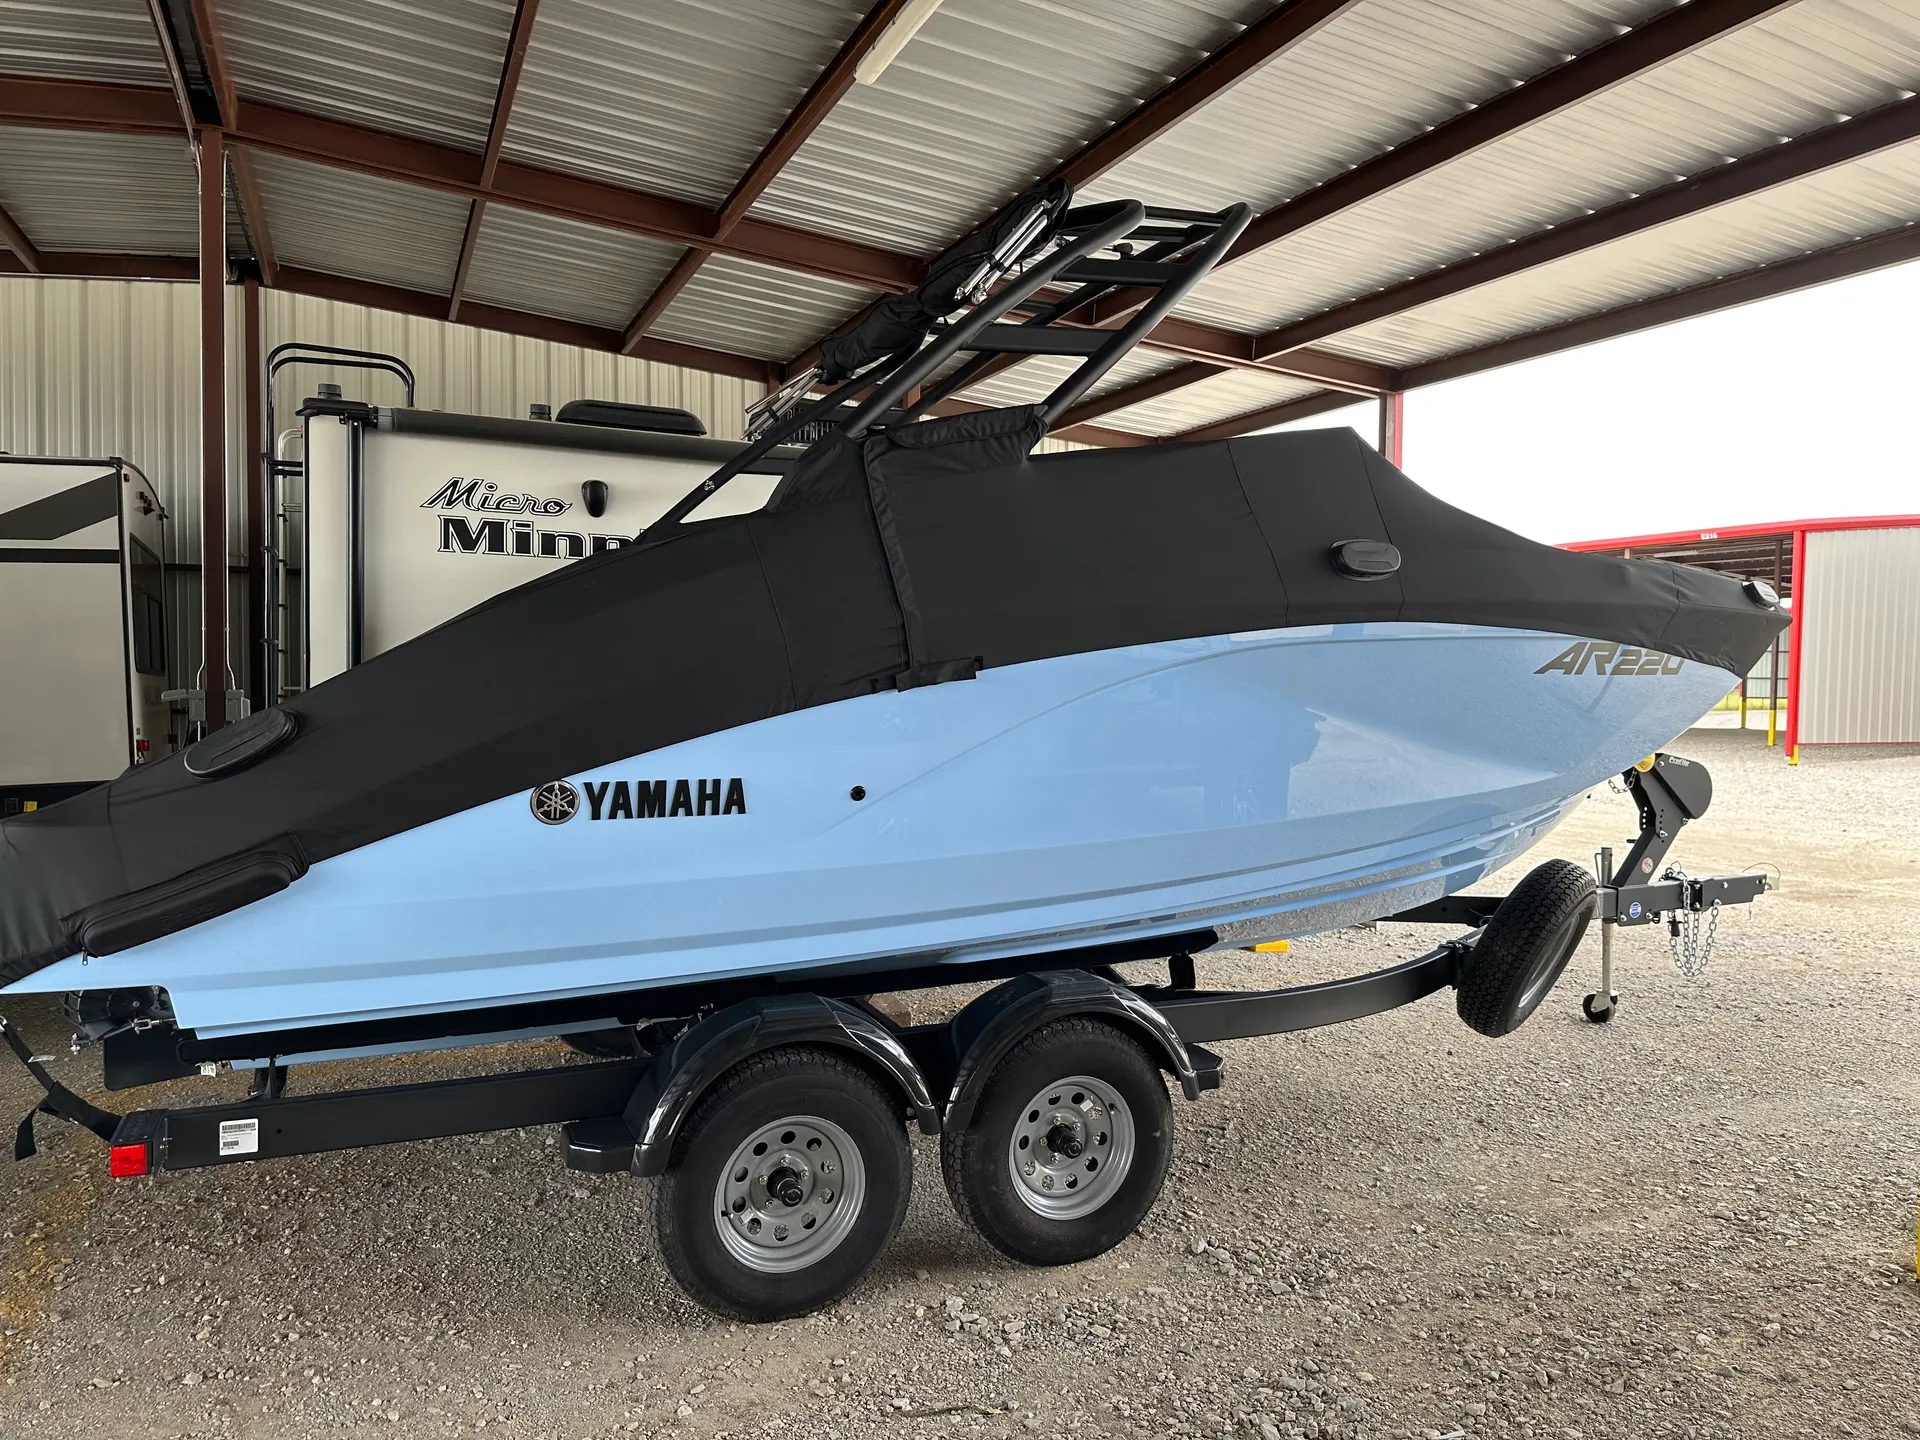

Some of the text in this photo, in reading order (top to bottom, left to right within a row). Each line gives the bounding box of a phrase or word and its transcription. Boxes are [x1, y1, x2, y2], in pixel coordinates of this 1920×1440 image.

[420, 477, 573, 516] Micro
[437, 515, 646, 560] Minn
[1533, 642, 1685, 676] AR220
[584, 777, 747, 821] YAMAHA
